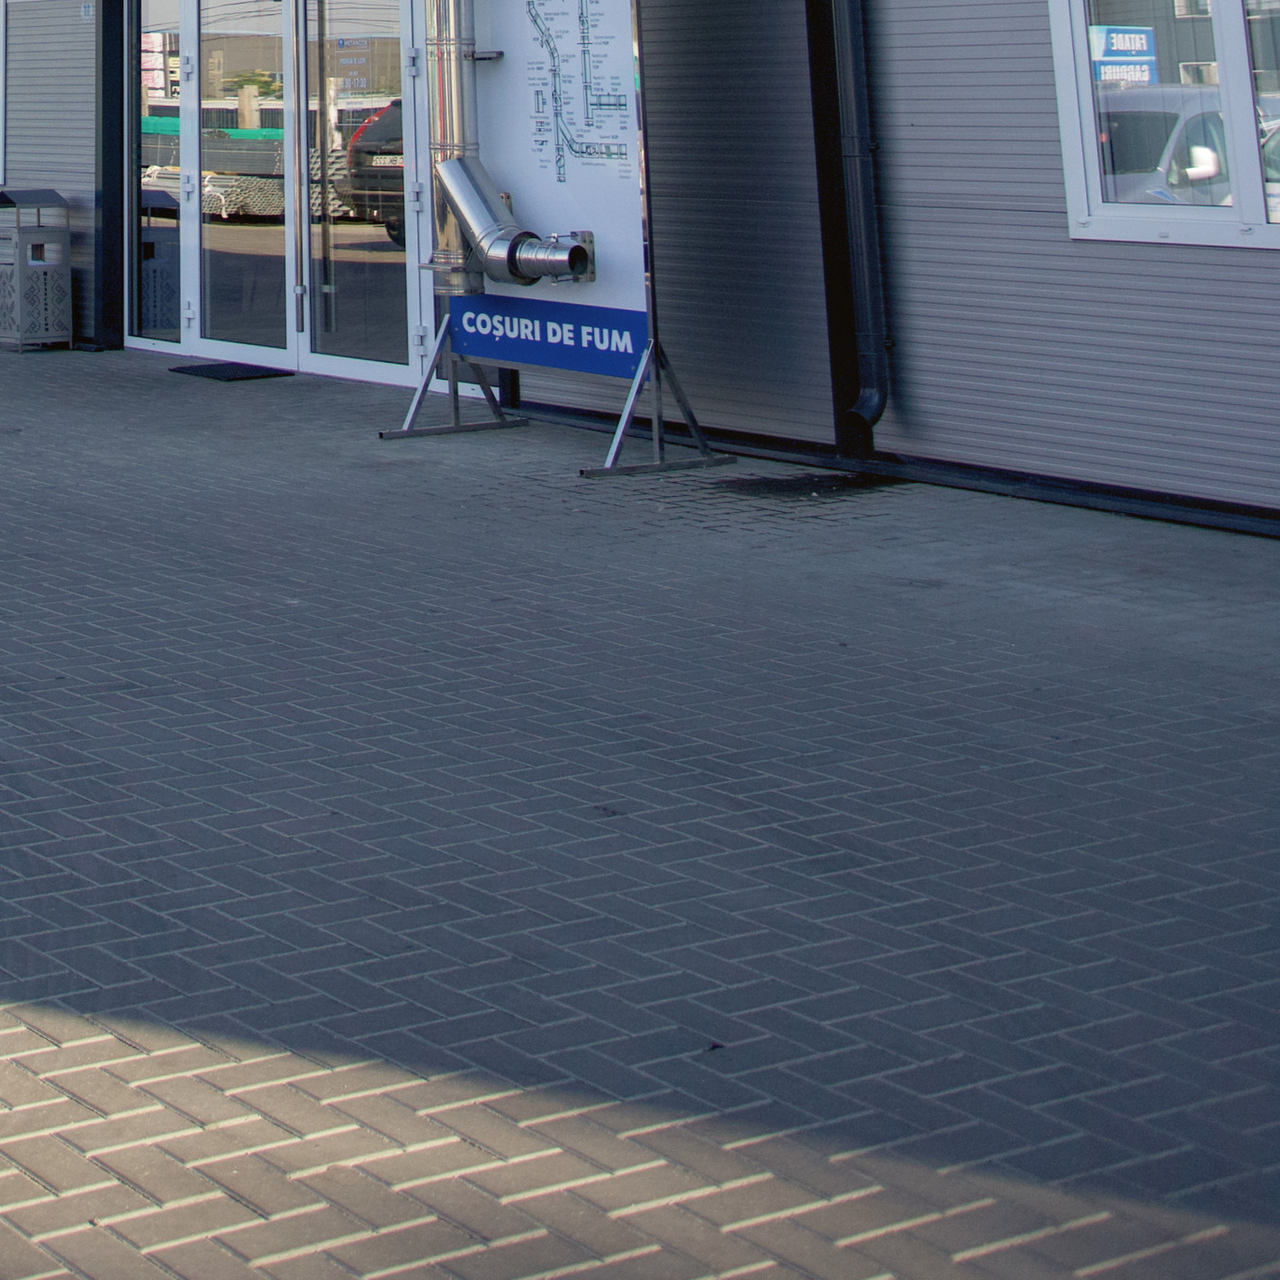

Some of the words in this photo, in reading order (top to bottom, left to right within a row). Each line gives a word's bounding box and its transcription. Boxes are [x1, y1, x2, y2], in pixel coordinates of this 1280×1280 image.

[461, 310, 541, 342] COȘURI
[546, 321, 575, 346] DE
[580, 325, 634, 354] FUM
